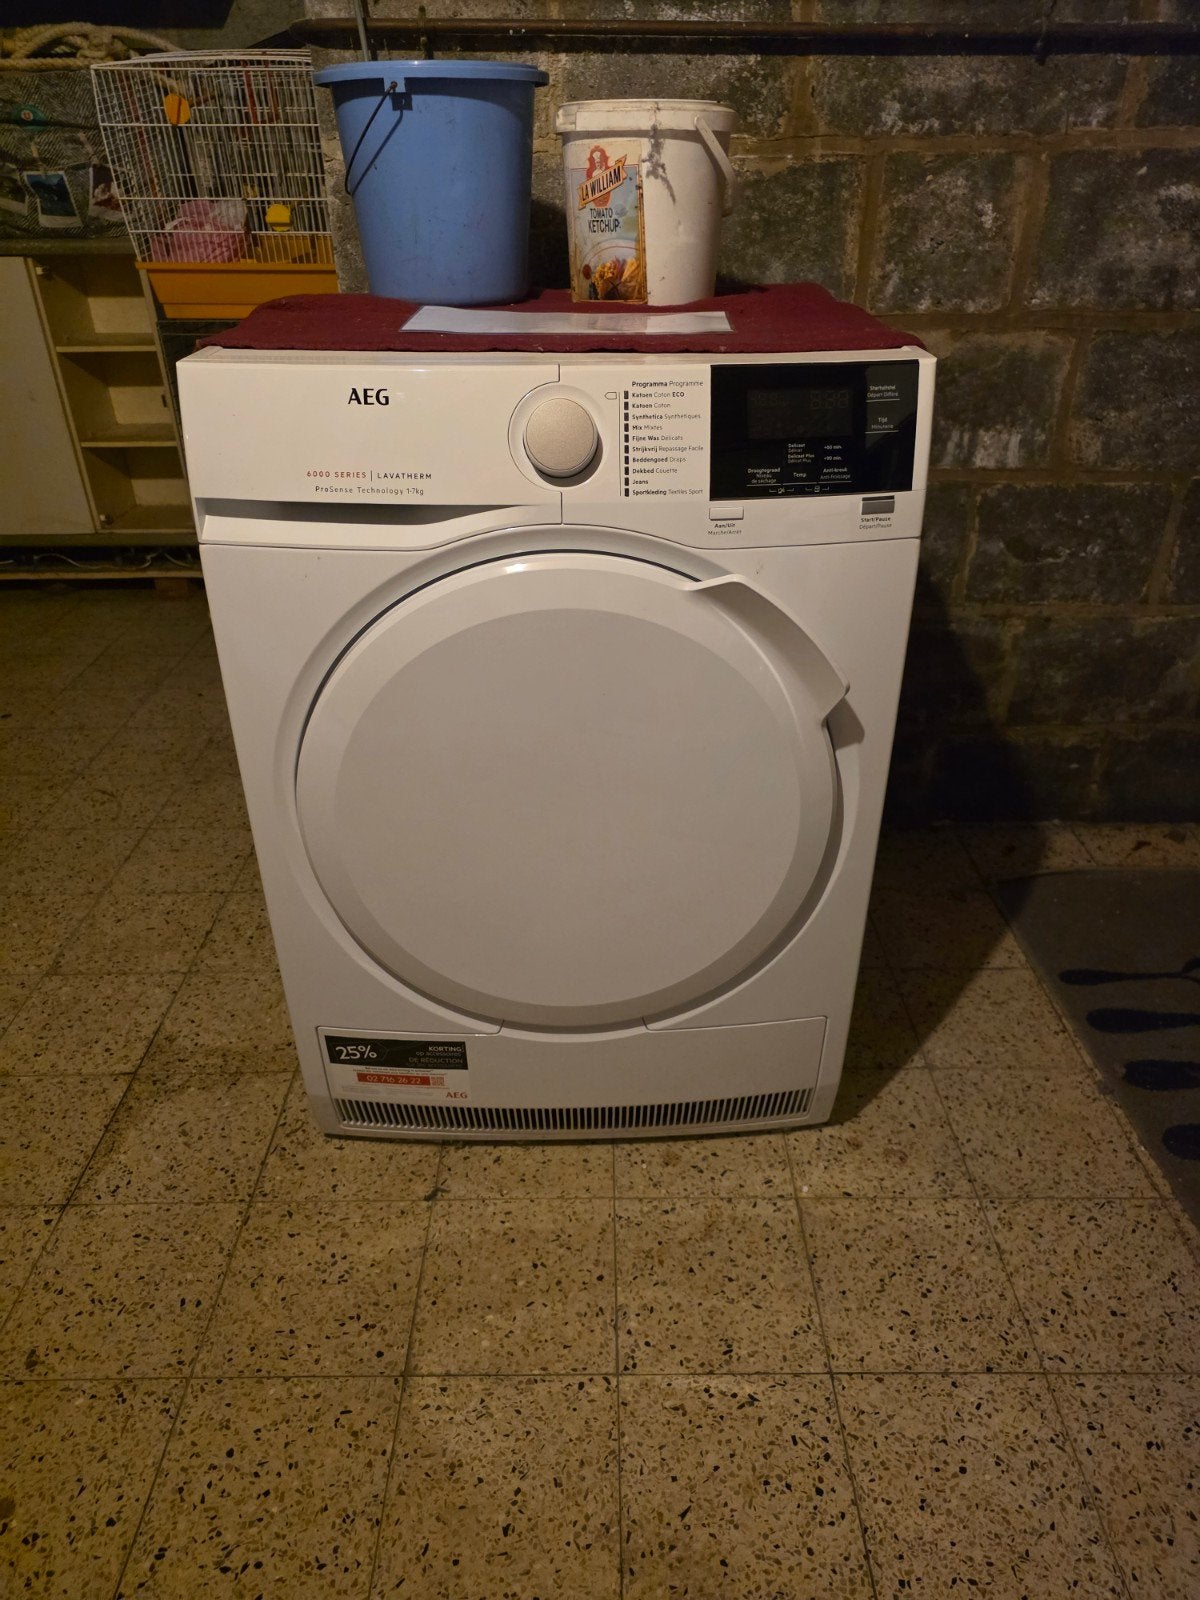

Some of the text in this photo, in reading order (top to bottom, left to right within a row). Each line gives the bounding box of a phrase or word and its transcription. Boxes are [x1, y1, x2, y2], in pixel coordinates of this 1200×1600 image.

[580, 165, 622, 202] LA WILLIAM
[590, 207, 613, 219] TOMATO
[588, 219, 620, 233] KETCHUP
[669, 380, 704, 388] Programme
[347, 387, 390, 406] AEG
[631, 413, 663, 421] Synthetica
[306, 470, 432, 480] 6000 SERIES LAVATHERM
[315, 485, 353, 494] ProSense
[356, 486, 403, 496] Technology
[688, 488, 703, 496] Sport
[335, 1045, 378, 1060] 25%
[446, 1091, 468, 1099] AEG
